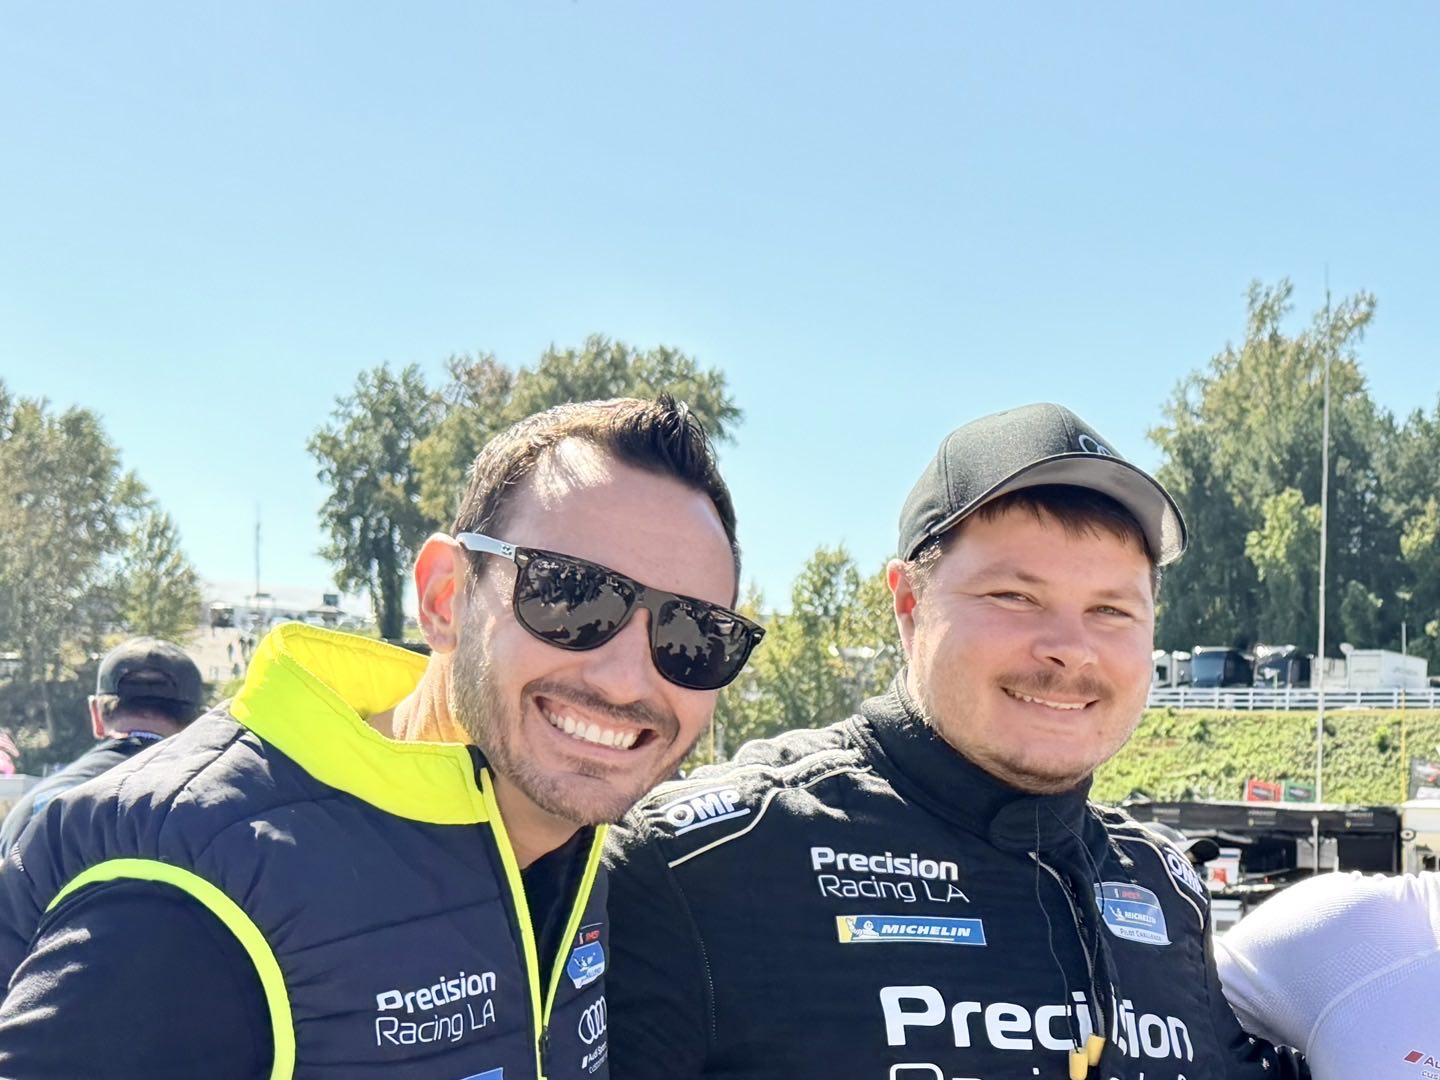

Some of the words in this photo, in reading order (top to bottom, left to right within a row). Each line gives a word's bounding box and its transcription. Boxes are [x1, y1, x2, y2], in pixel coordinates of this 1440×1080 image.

[664, 789, 740, 827] OMP
[810, 846, 959, 881] Precision
[818, 874, 915, 903] Racing
[925, 880, 970, 903] LA
[880, 922, 971, 938] MICHELIN
[376, 971, 496, 1013] Precision
[376, 1012, 463, 1046] Racing
[468, 998, 496, 1030] LA
